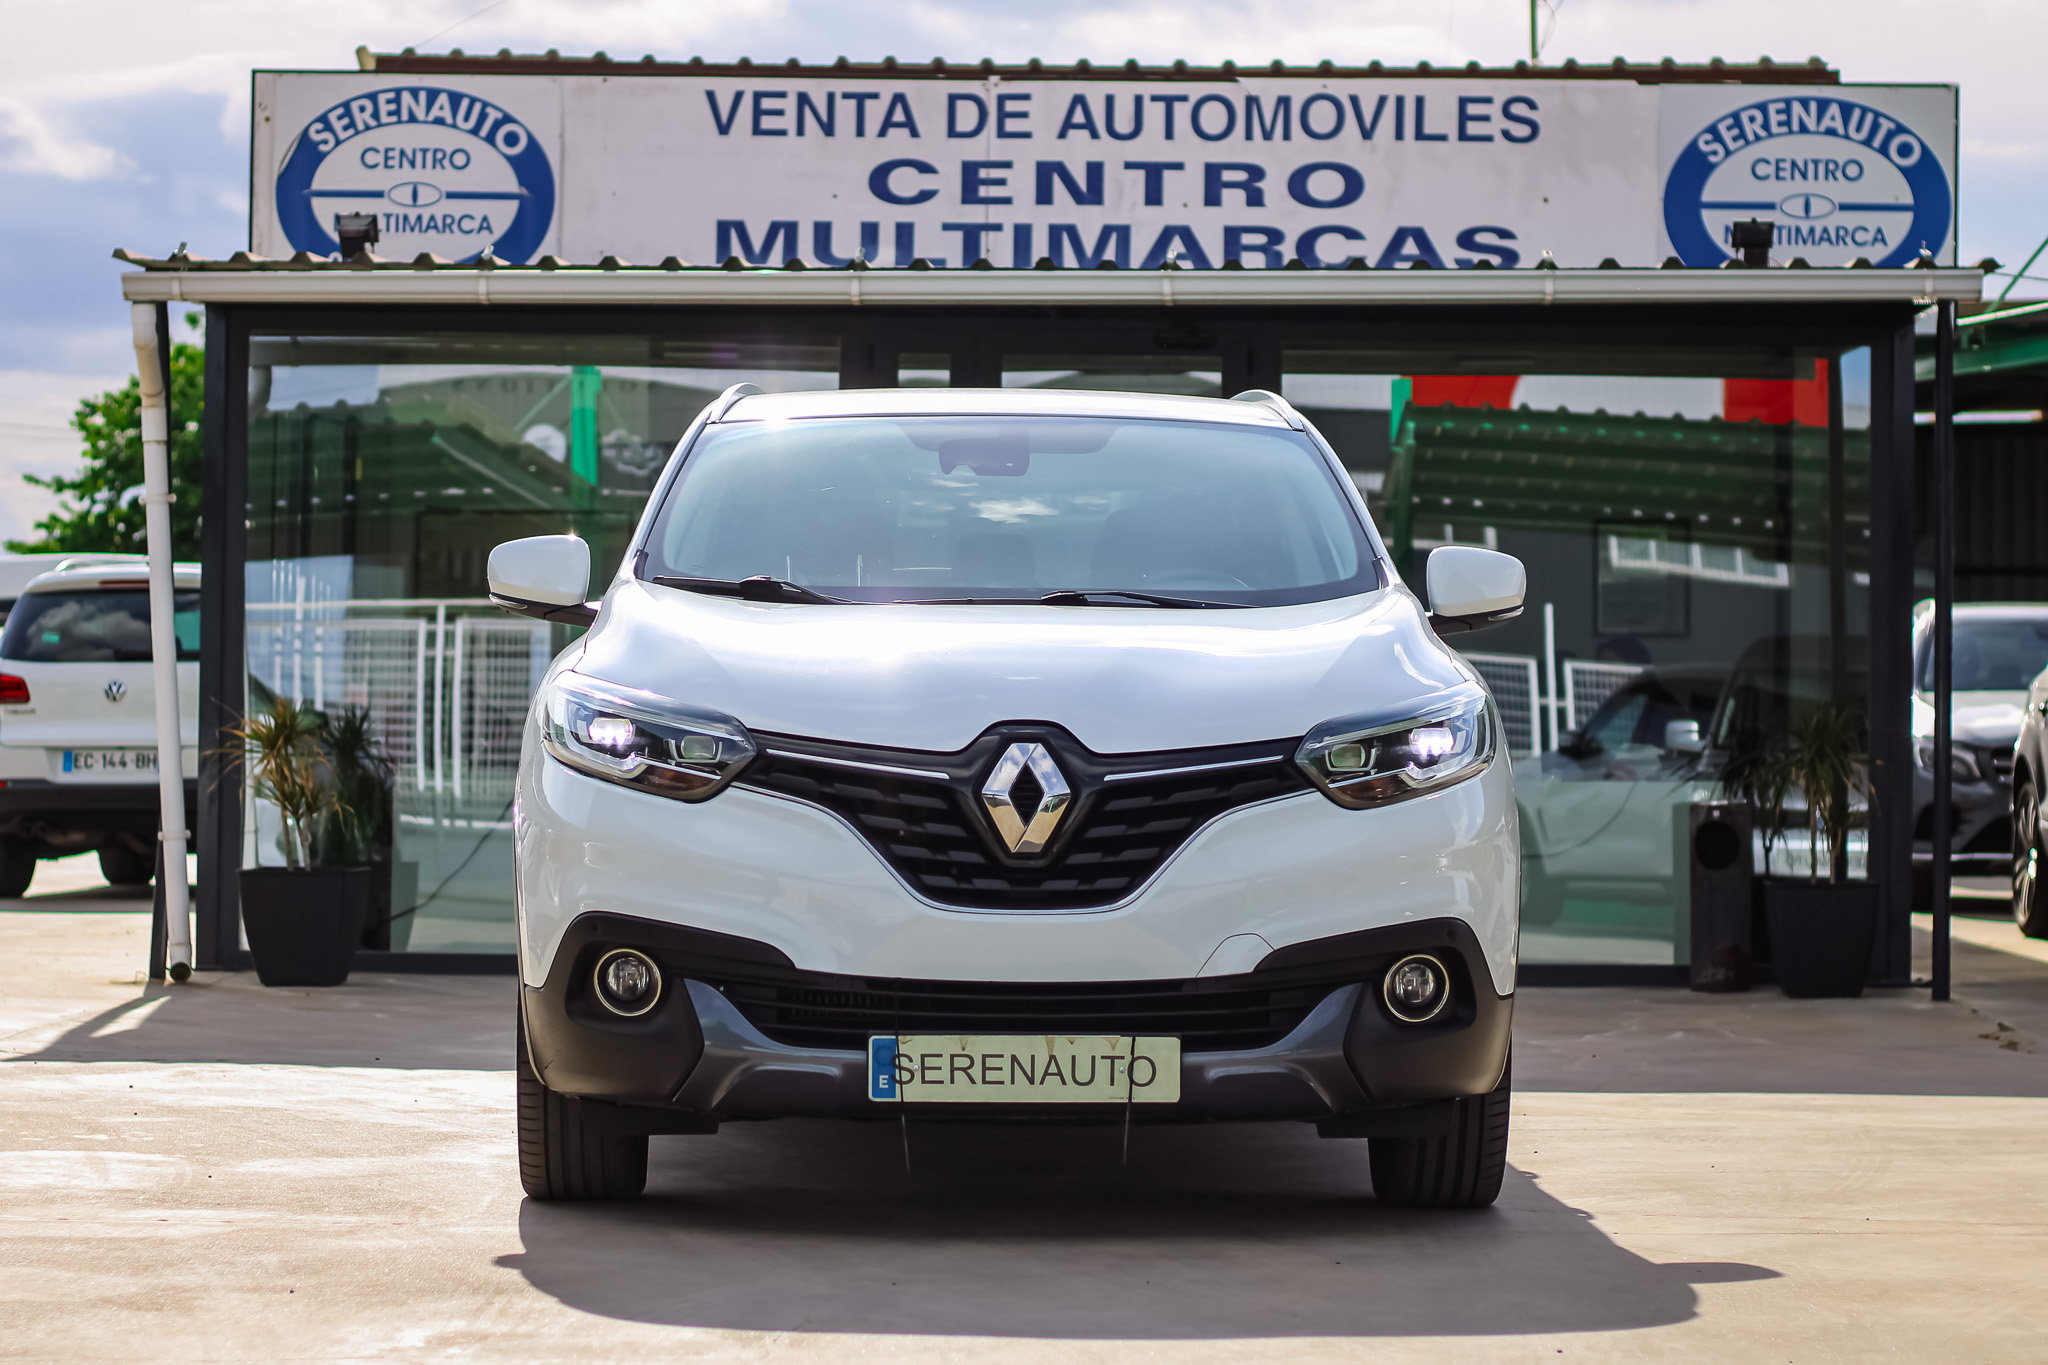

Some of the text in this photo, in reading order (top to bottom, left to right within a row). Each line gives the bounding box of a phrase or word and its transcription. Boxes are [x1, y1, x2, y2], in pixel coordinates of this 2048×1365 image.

[308, 90, 529, 156] SERENAUTO
[705, 89, 1541, 144] VENTA DE AUTOMOVILES
[1698, 100, 1922, 168] SERENAUTO
[360, 147, 471, 170] CENTRO
[1751, 157, 1864, 182] CENTRO
[867, 158, 1366, 209] CENTRO
[334, 213, 494, 234] TIMARCA
[716, 219, 1521, 269] MULTIMARCAS
[879, 1075, 889, 1088] E
[890, 1052, 1157, 1087] SERENAUTO
